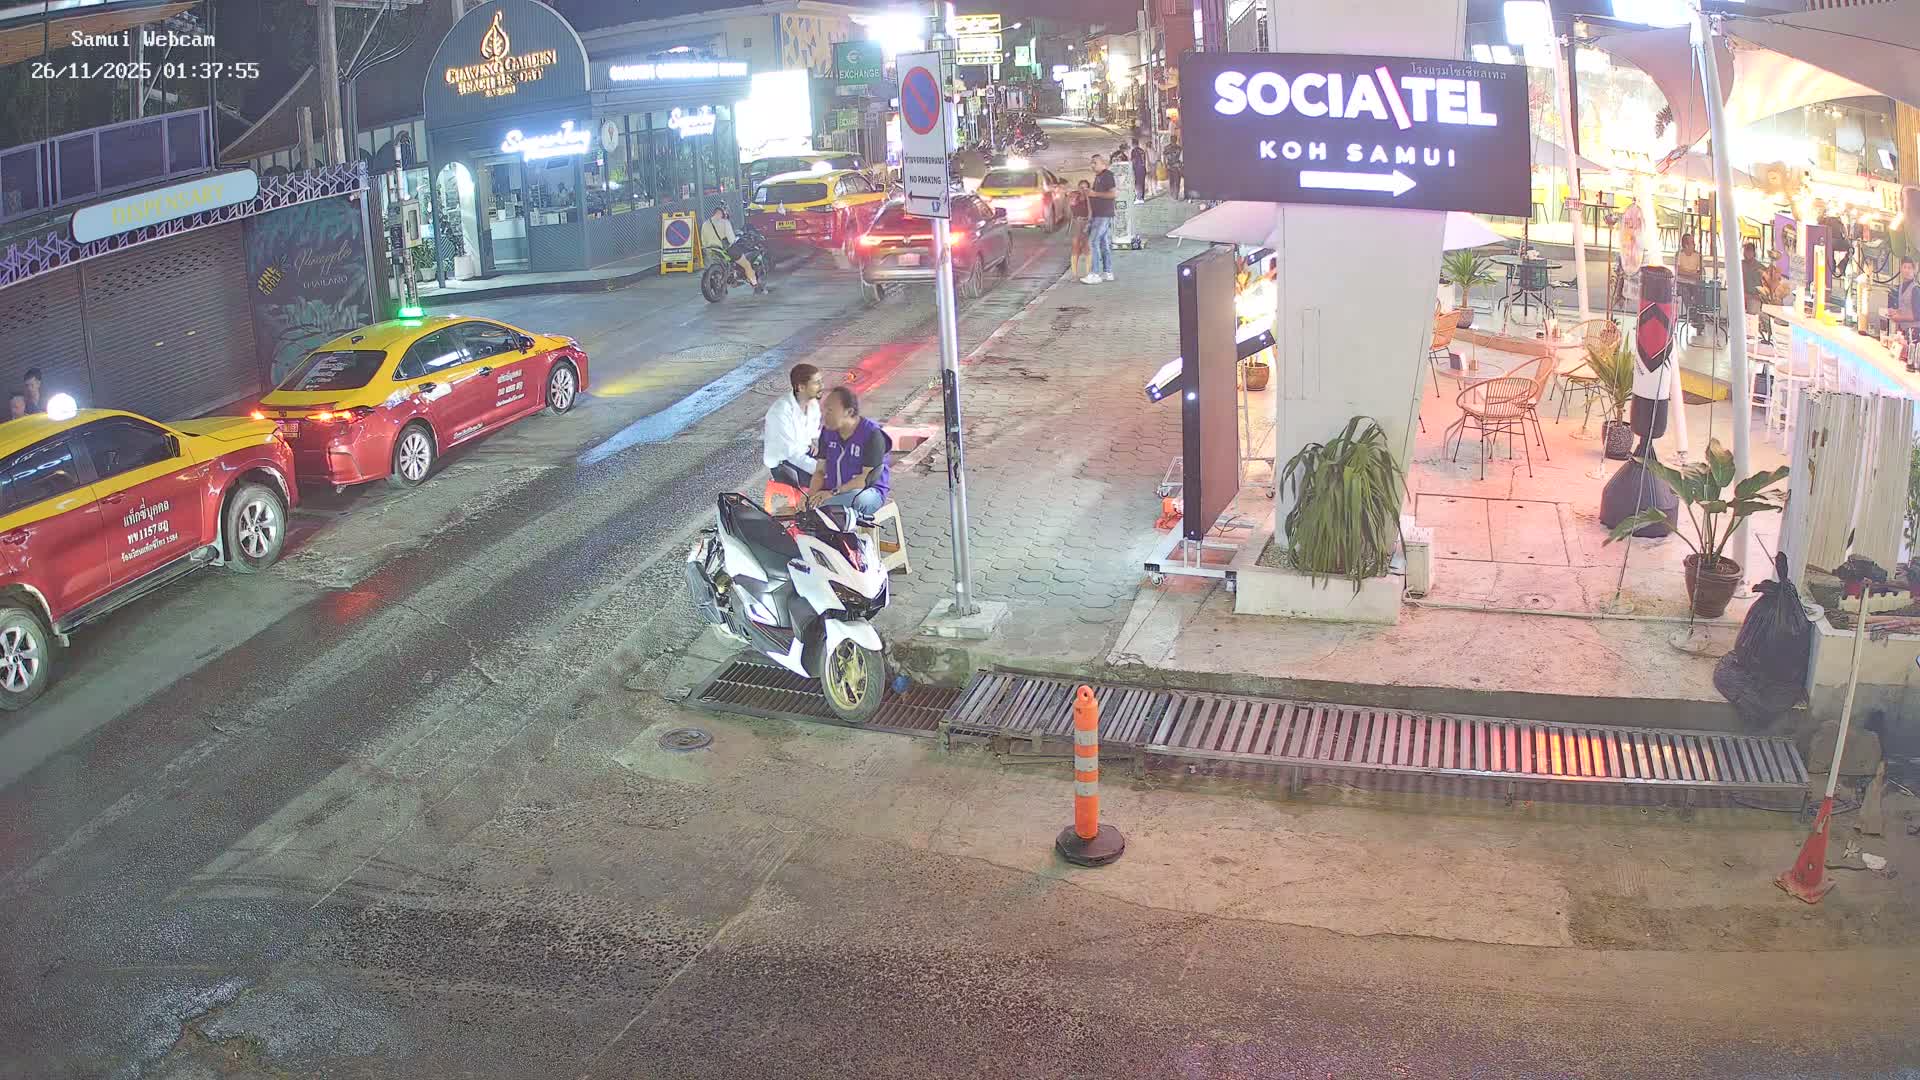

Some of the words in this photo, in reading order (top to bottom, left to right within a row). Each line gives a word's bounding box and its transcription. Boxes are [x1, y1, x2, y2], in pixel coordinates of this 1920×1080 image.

[840, 69, 880, 79] EXCHANGE
[1260, 140, 1327, 160] KOH
[1346, 144, 1456, 167] SAMUI
[909, 175, 917, 184] NO
[918, 175, 942, 185] PARKING
[112, 184, 224, 225] DISPENSARY
[123, 497, 170, 528] แท็กซี่บุคคล
